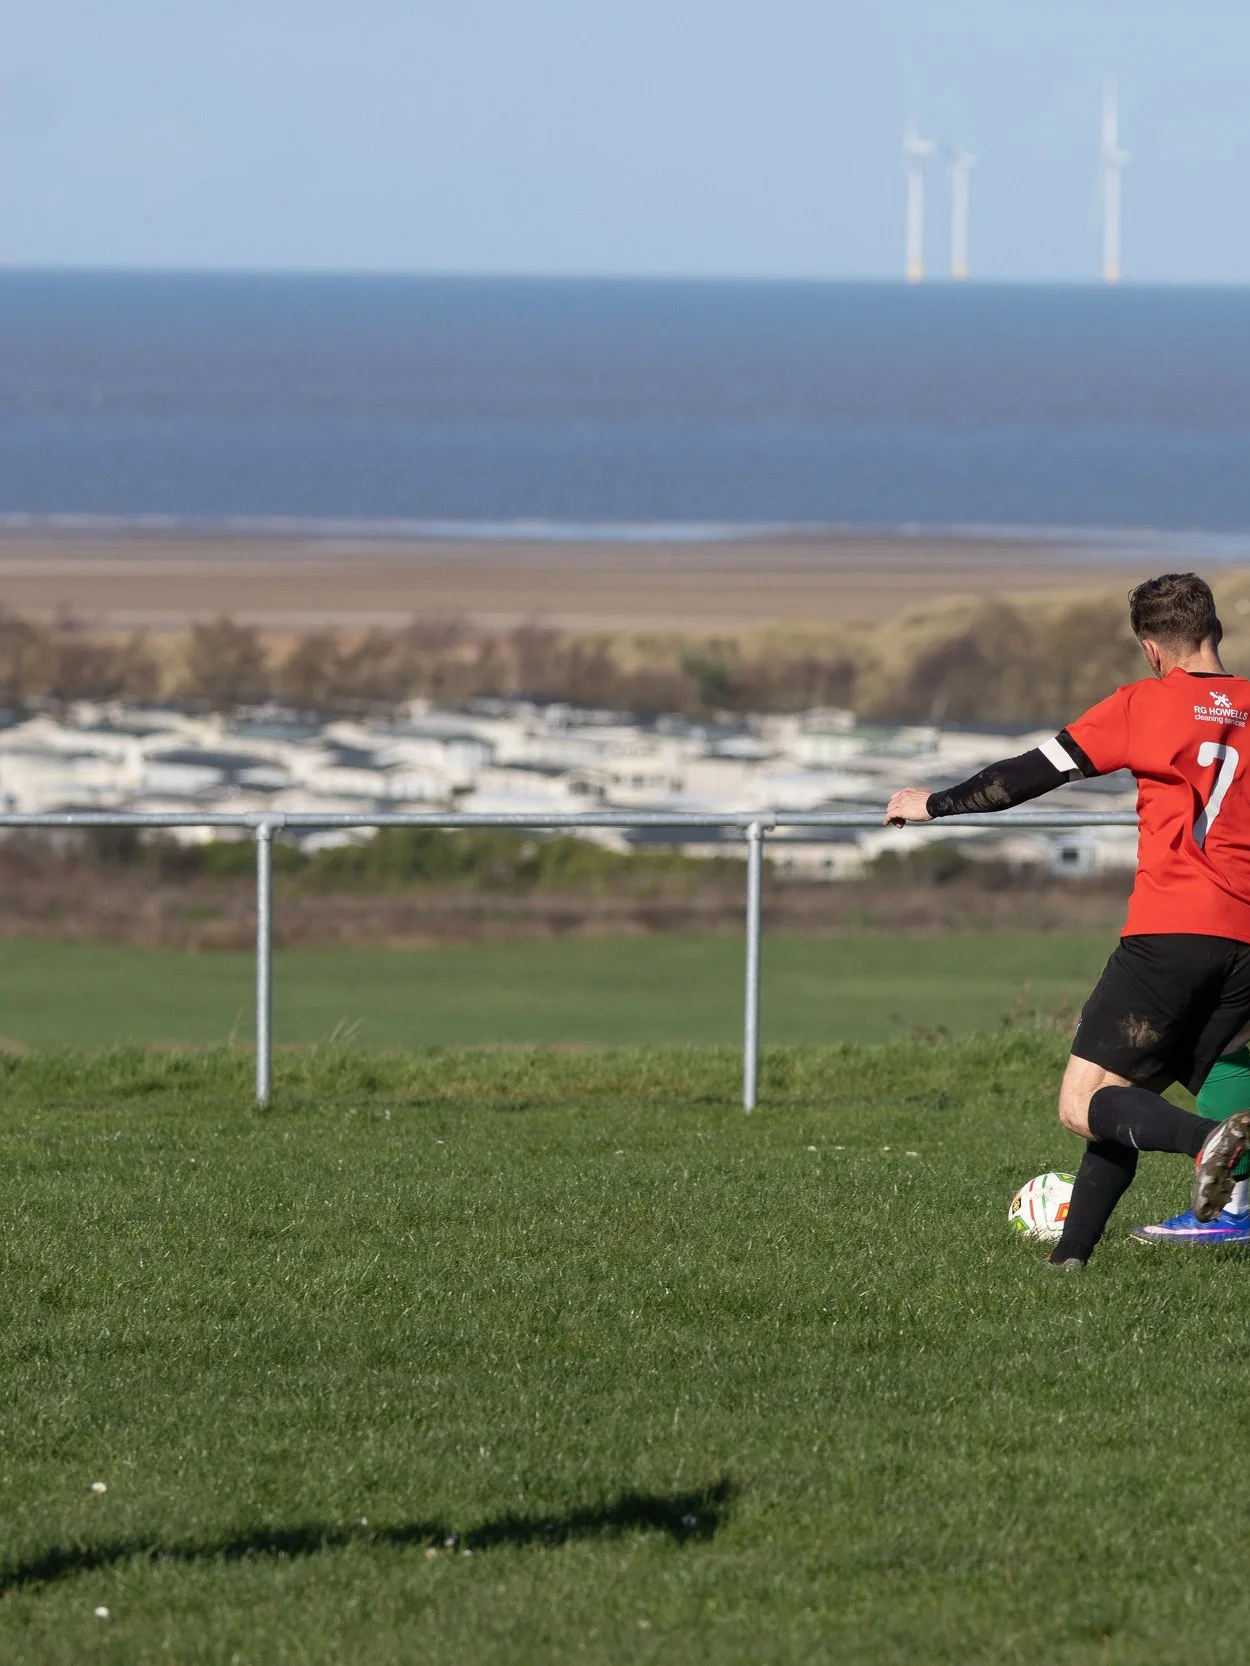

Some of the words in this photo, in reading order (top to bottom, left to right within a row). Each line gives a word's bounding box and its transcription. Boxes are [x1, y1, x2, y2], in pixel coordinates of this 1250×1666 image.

[1194, 705, 1207, 714] RG
[1209, 707, 1249, 720] HOWELLS
[1194, 714, 1224, 724] cleaning
[1193, 741, 1240, 848] 7
